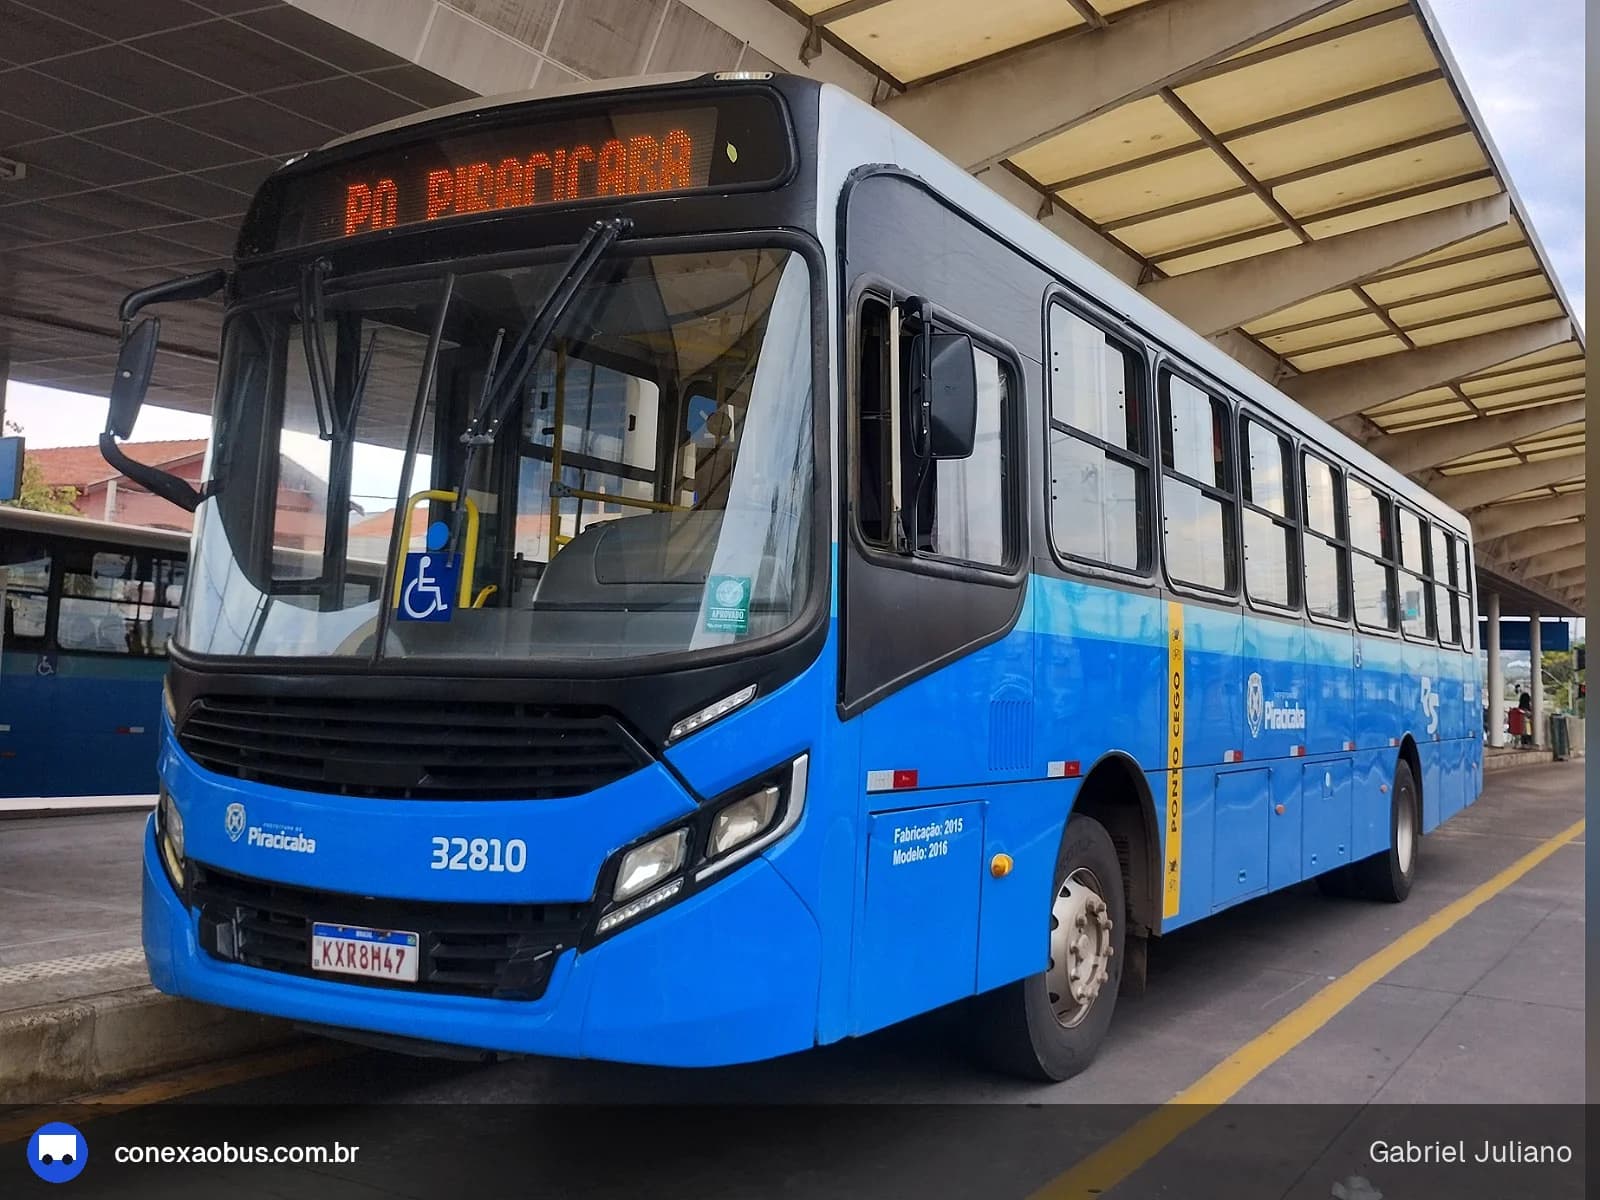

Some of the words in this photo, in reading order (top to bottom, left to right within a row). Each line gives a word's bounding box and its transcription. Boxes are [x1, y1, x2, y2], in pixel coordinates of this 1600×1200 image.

[1173, 672, 1181, 737] CEGO
[1264, 700, 1305, 730] Piracicaba
[1171, 747, 1179, 832] PONTO
[247, 826, 316, 853] Piracicaba
[894, 822, 943, 844] Fabricação:
[944, 817, 963, 835] 2015
[430, 836, 527, 873] 32810
[893, 845, 927, 865] Modelo:
[928, 840, 948, 858] 2016
[322, 940, 405, 974] KXR8H47
